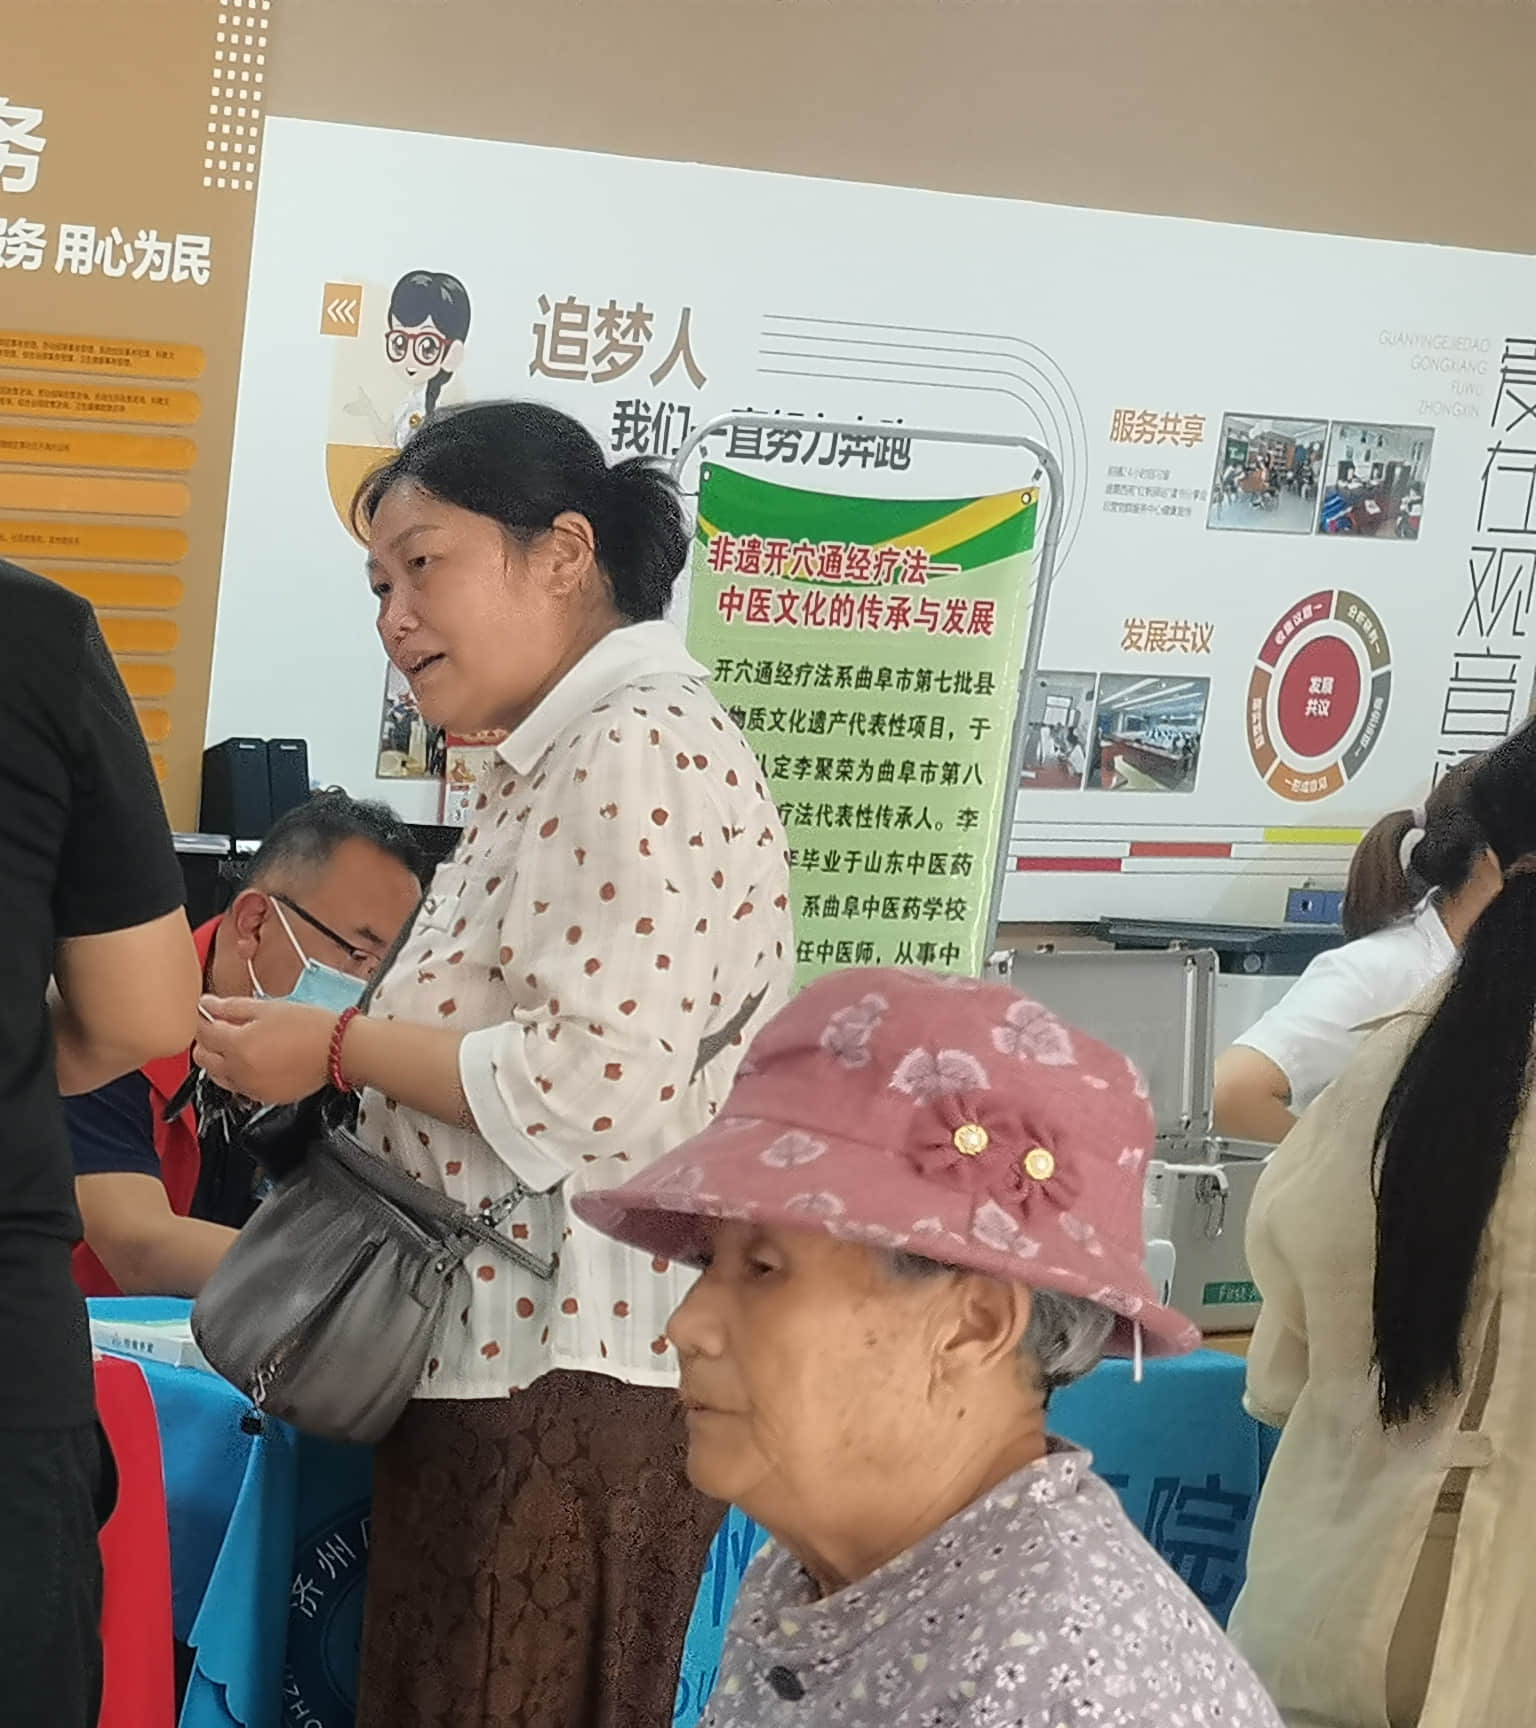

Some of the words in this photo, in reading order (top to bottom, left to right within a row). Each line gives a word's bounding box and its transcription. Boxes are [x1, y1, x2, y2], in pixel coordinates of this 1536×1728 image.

[55, 223, 212, 286] 用心为民
[529, 294, 708, 391] 追梦人
[1110, 408, 1207, 448] 服务共享
[1431, 337, 1536, 792] 爱在观音
[718, 585, 995, 636] 中医文化的传承与发展
[1121, 617, 1215, 654] 发展共议
[714, 658, 996, 696] 开穴通经疗法系曲阜市第七批县
[796, 939, 961, 967] 任中医师，从事中
